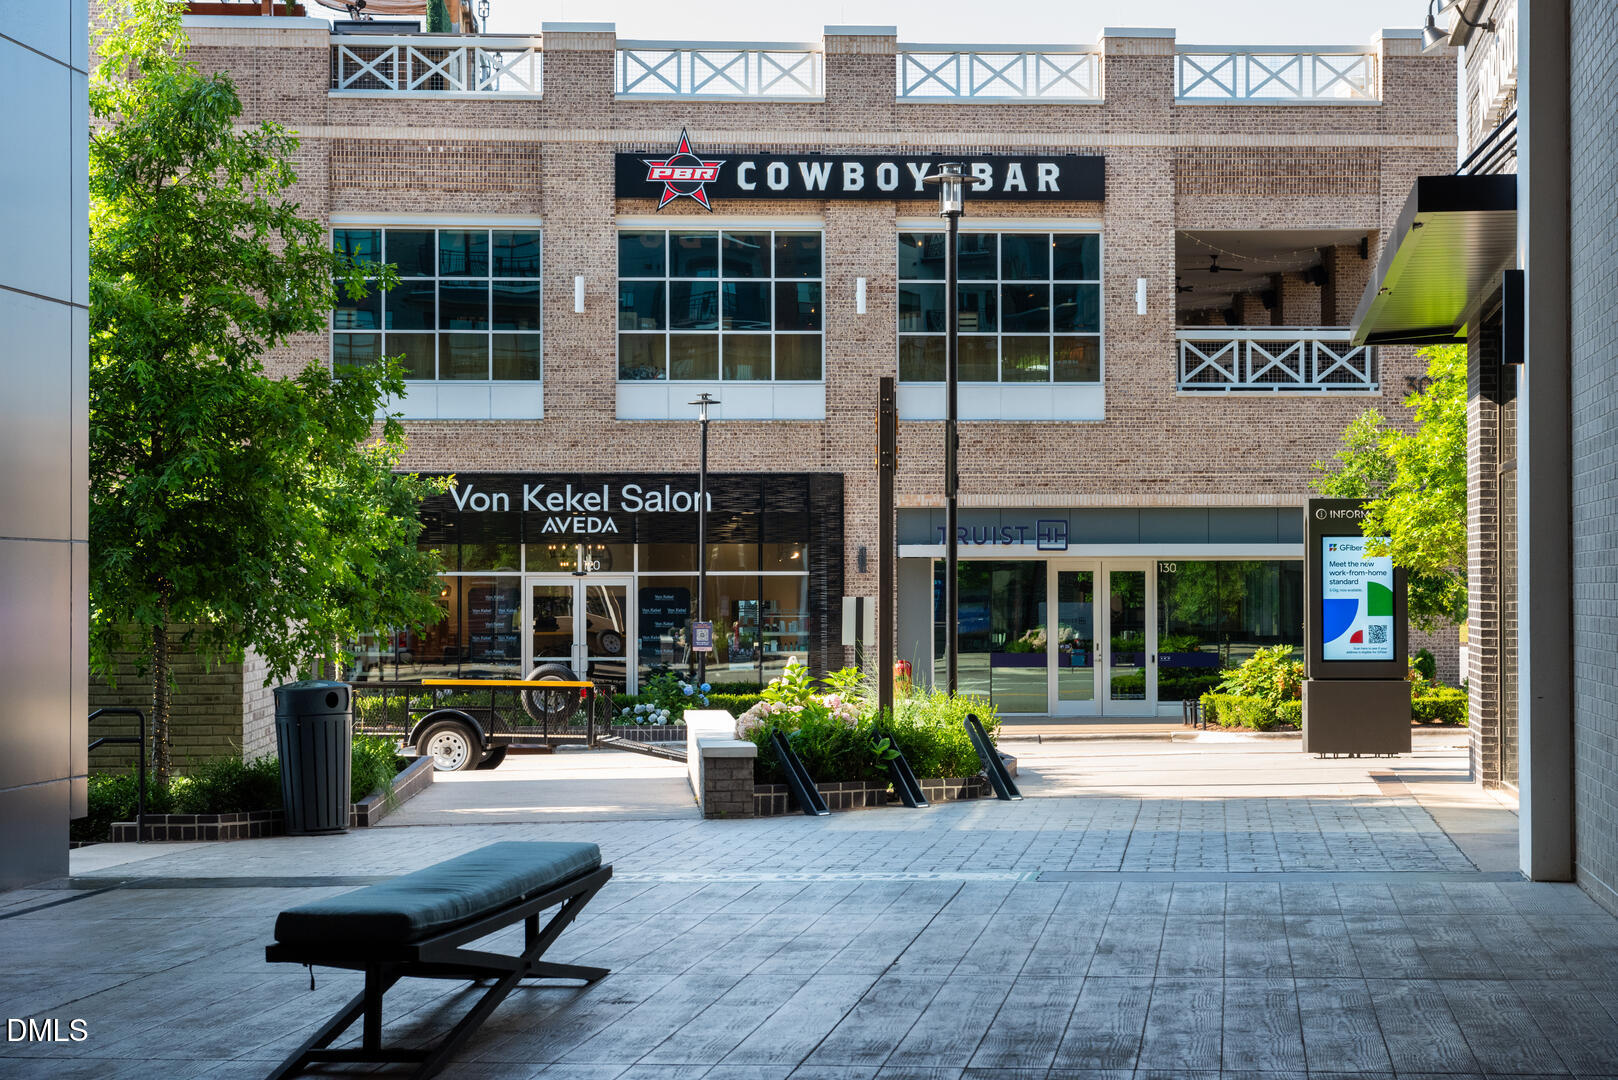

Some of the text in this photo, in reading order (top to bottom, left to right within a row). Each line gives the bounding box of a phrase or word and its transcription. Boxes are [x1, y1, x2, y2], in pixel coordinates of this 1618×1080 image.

[652, 168, 715, 180] PBR
[736, 161, 1061, 192] COWBOY BAR
[450, 484, 712, 512] Von Kekel Salon
[541, 517, 619, 534] AVEDA
[937, 526, 1029, 545] TRUIST
[1339, 543, 1362, 551] GFiber
[1159, 562, 1177, 573] 130
